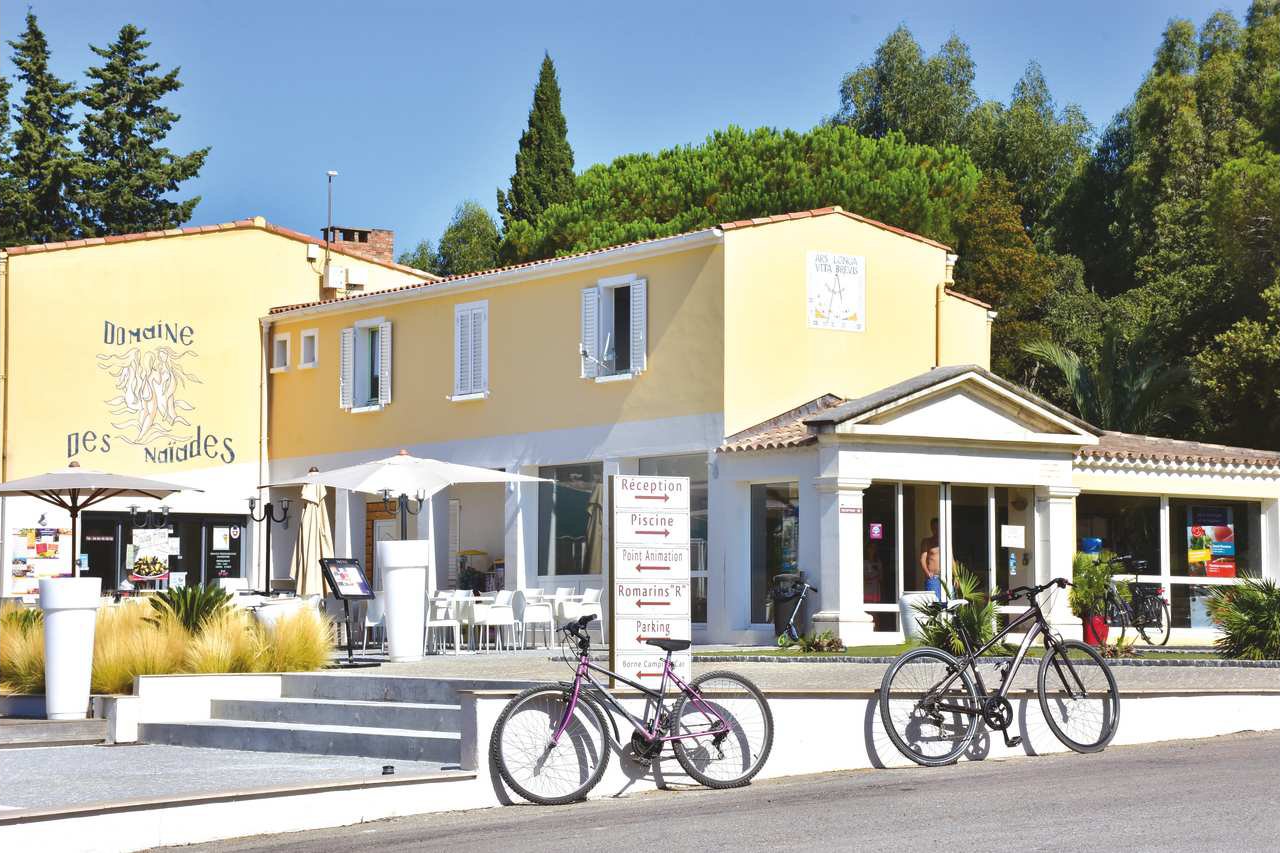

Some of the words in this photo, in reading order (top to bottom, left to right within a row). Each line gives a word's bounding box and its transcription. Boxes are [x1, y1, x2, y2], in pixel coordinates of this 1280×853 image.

[815, 264, 832, 273] VITA
[621, 478, 682, 494] Réception
[630, 513, 674, 527] Piscine
[622, 549, 642, 562] Point
[645, 549, 683, 562] Animation
[636, 620, 671, 637] Parking
[622, 660, 641, 668] Borne
